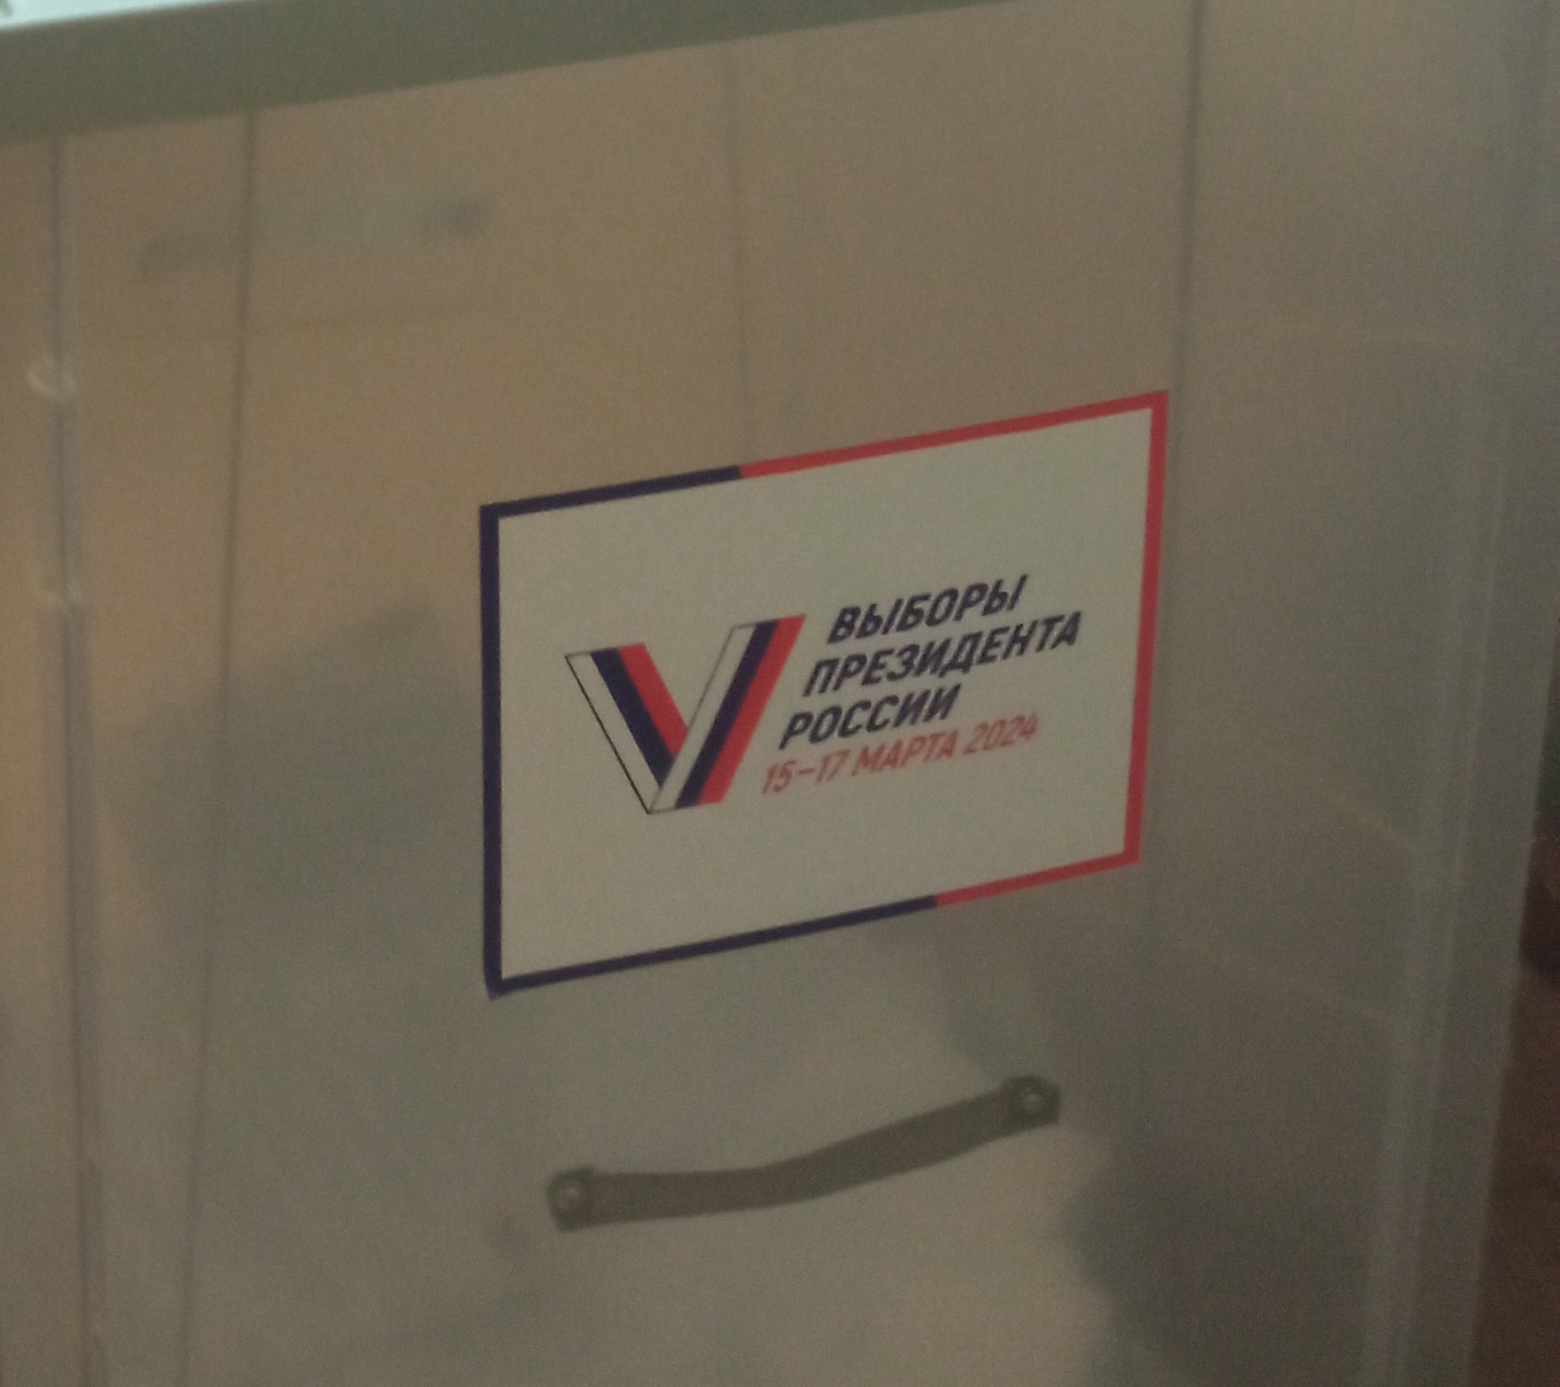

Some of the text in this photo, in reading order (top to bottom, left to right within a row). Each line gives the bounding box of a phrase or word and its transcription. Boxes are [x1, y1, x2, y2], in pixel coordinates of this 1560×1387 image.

[827, 574, 1029, 645] ВЫБОРЫ
[801, 610, 1083, 698] ПРЕЗИДЕНТА
[778, 682, 962, 751] РОССИИ
[851, 729, 960, 777] МАРТА
[962, 711, 1039, 755] 2024
